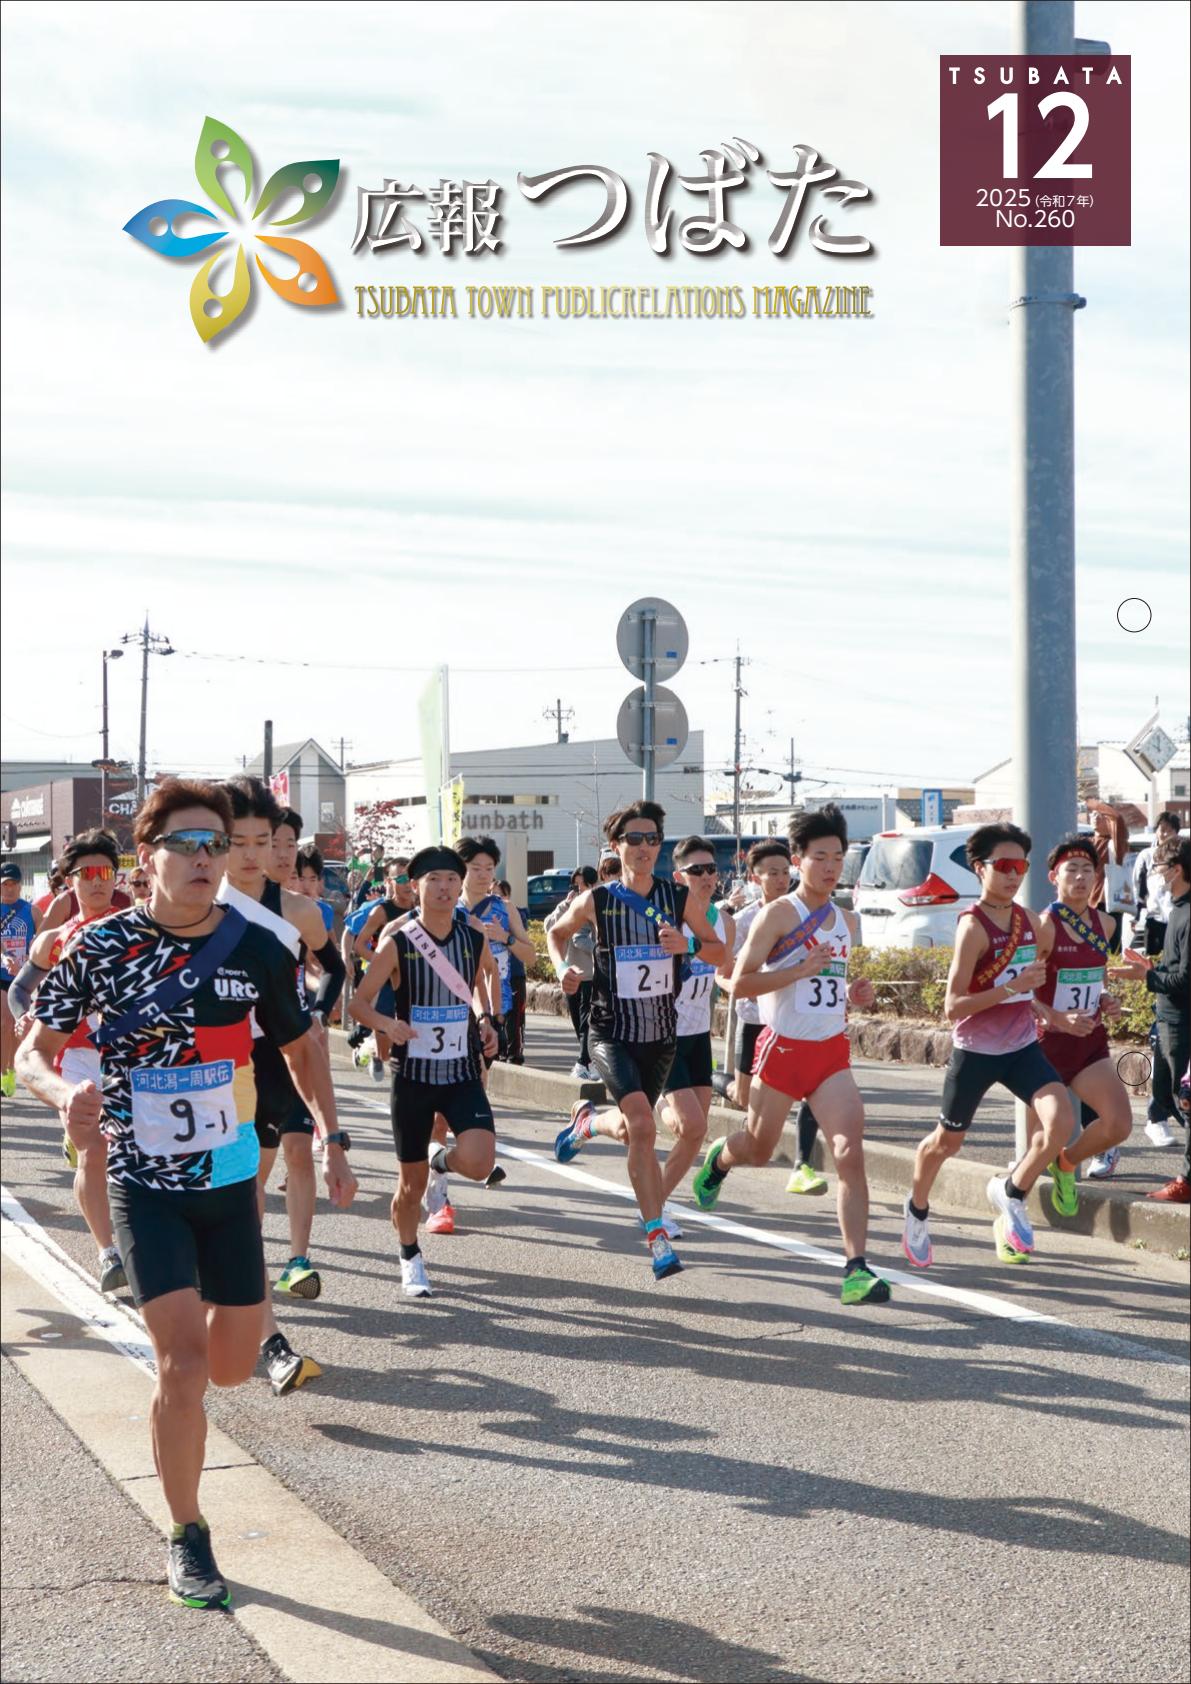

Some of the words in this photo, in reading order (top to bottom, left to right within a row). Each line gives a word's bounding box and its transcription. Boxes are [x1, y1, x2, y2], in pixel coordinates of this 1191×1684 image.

[214, 978, 260, 999] URC
[638, 964, 668, 992] 2-1
[430, 1026, 462, 1053] 3-1
[136, 1065, 230, 1090] 河北潟一周駅伝
[170, 1098, 228, 1142] 9-1
